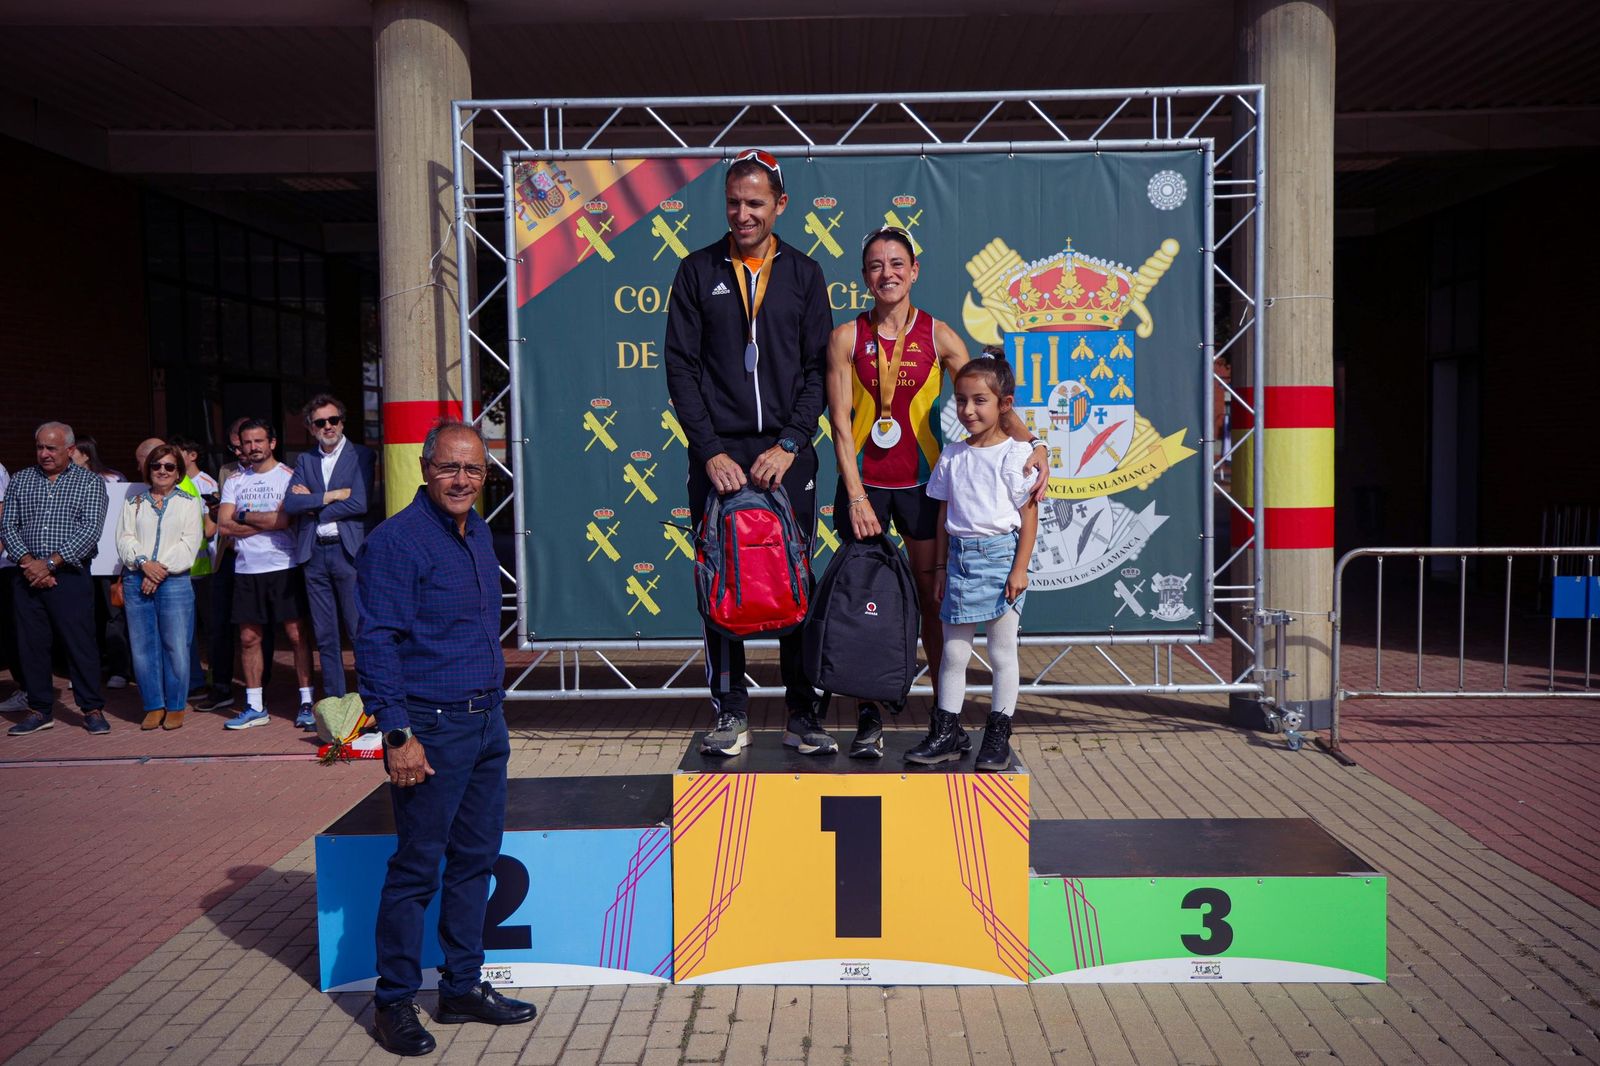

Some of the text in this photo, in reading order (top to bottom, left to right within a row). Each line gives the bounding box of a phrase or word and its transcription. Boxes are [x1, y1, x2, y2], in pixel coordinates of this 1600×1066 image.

[616, 341, 660, 369] DE
[1089, 462, 1158, 493] SALAMANCA
[1090, 536, 1142, 574] SALAMANCA
[821, 796, 882, 938] 1
[482, 854, 532, 950] 2
[1180, 887, 1234, 956] 3
